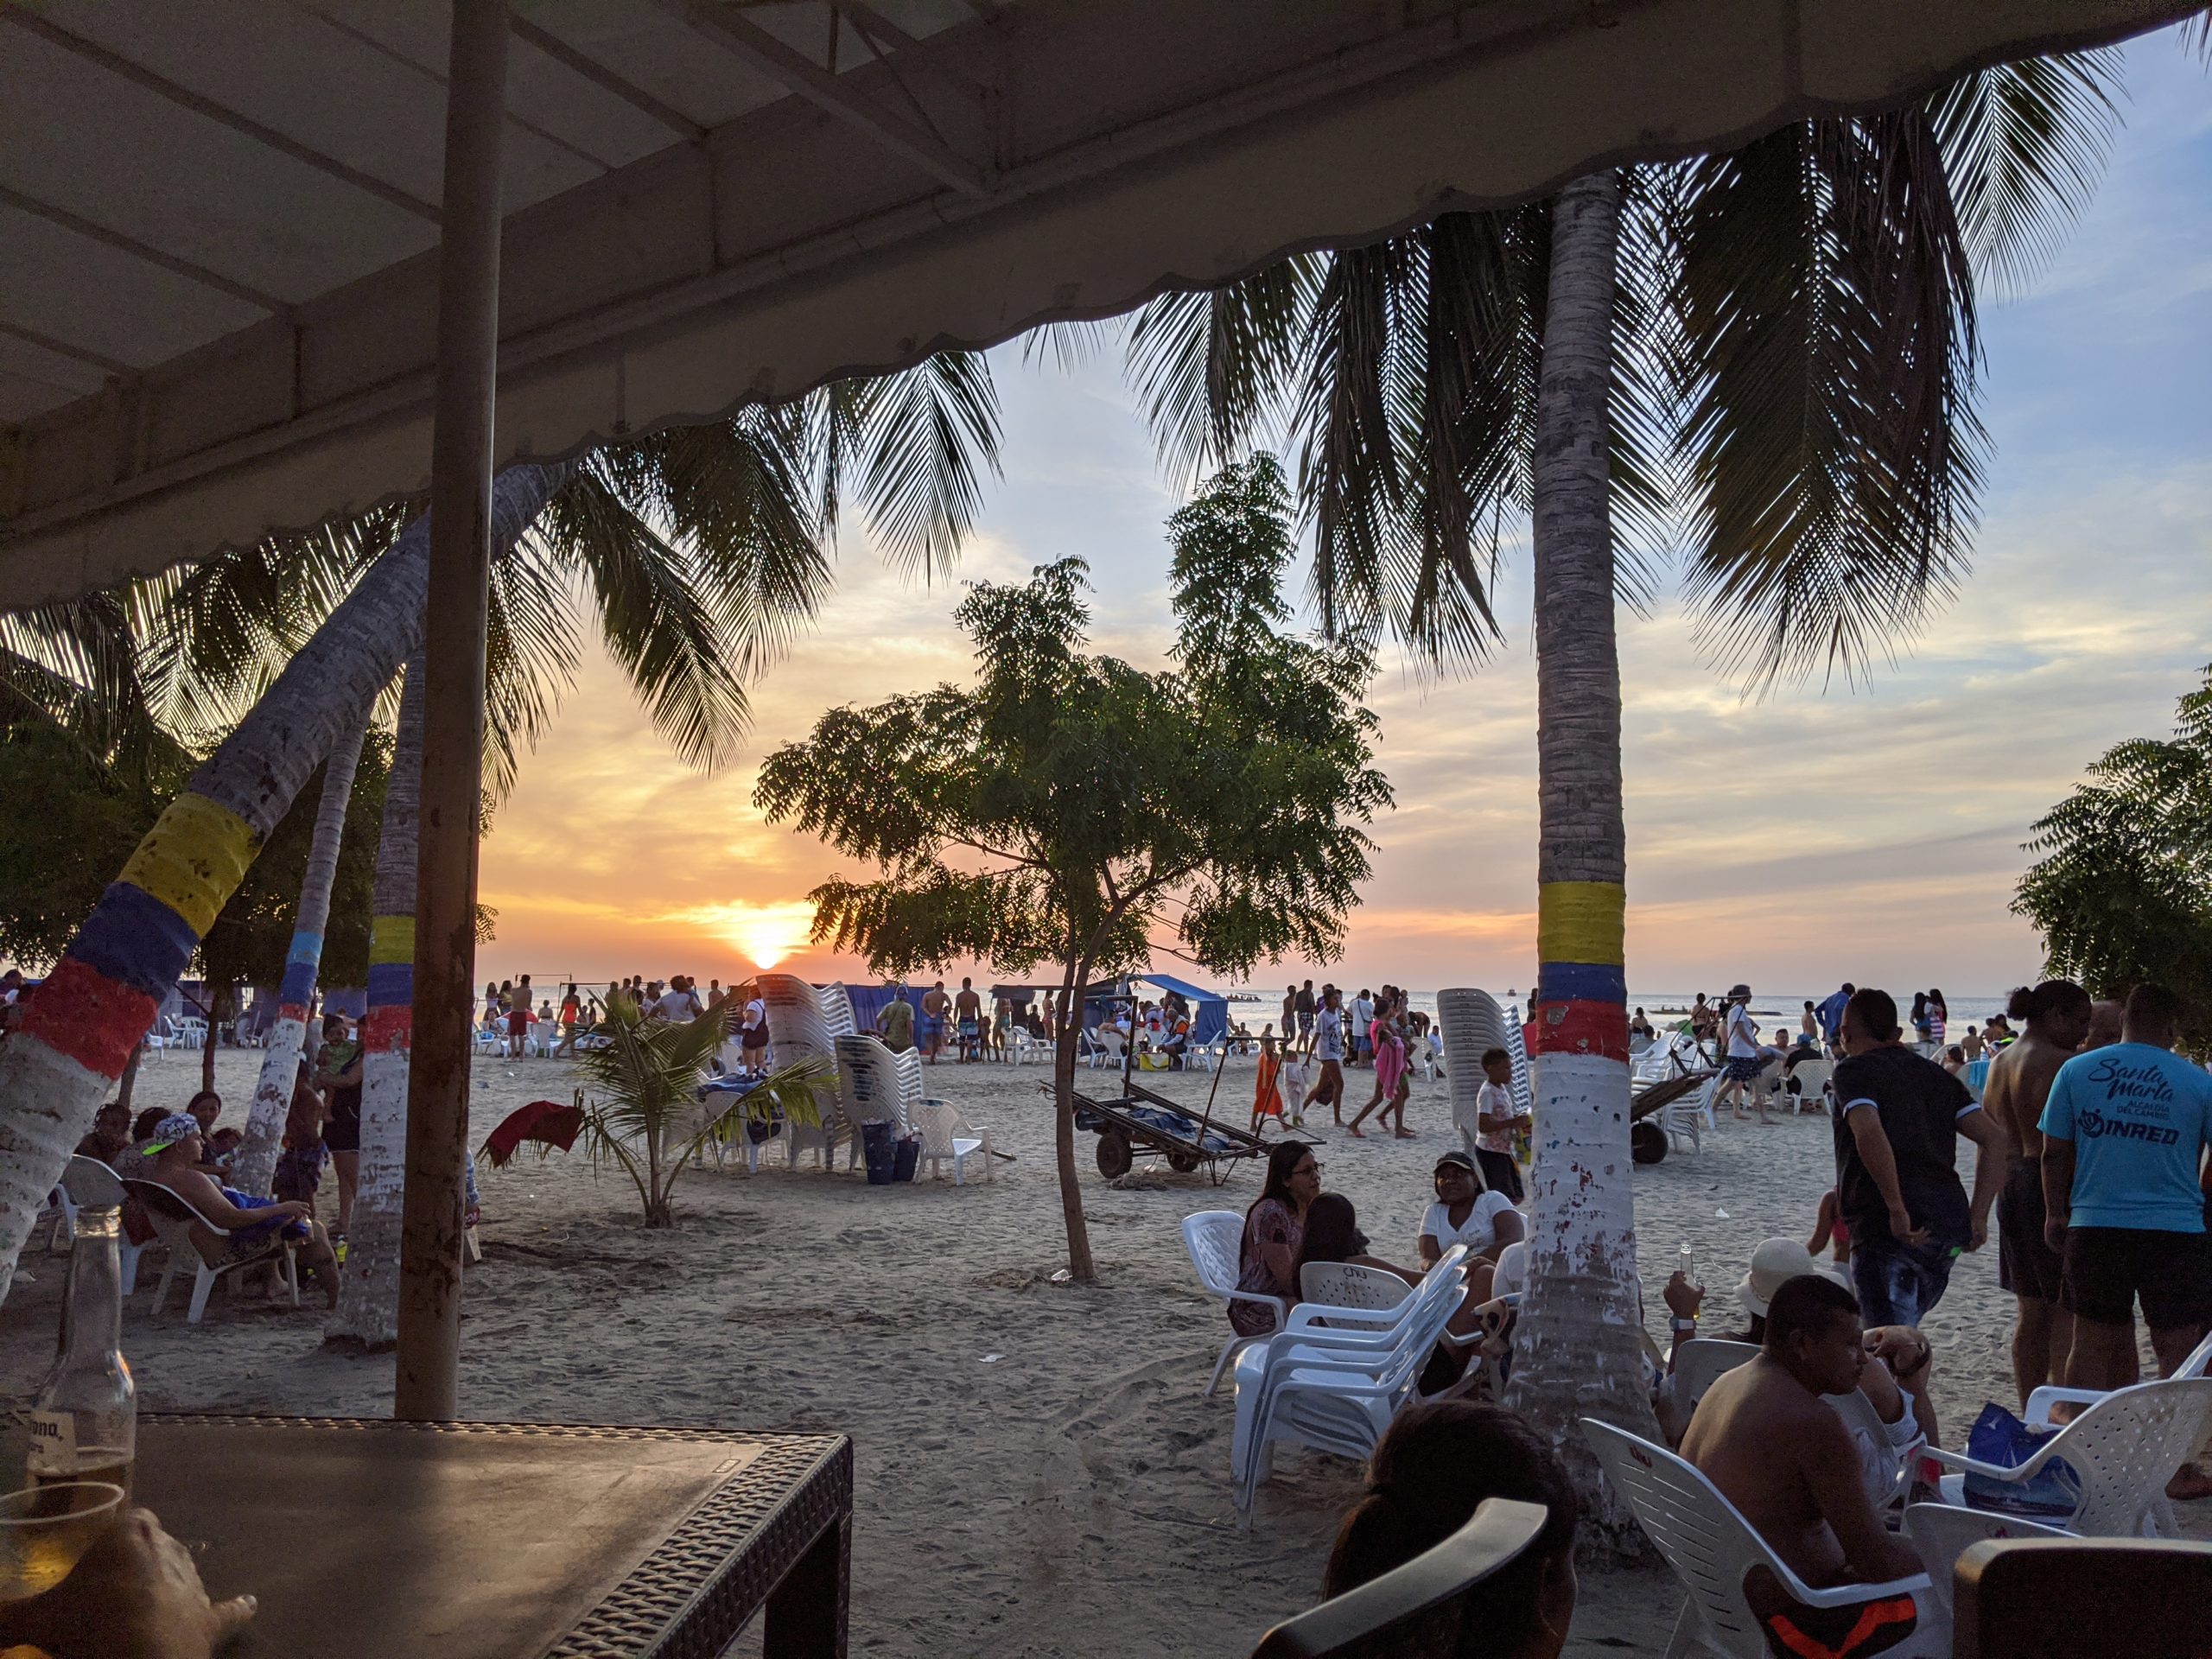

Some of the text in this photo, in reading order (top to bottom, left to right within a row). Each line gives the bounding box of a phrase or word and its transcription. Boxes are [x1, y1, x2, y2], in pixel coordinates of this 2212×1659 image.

[2088, 1058, 2164, 1083] Santa
[2107, 1078, 2175, 1102] Marta
[2116, 1105, 2133, 1114] DEL
[2105, 1119, 2180, 1146] INRED
